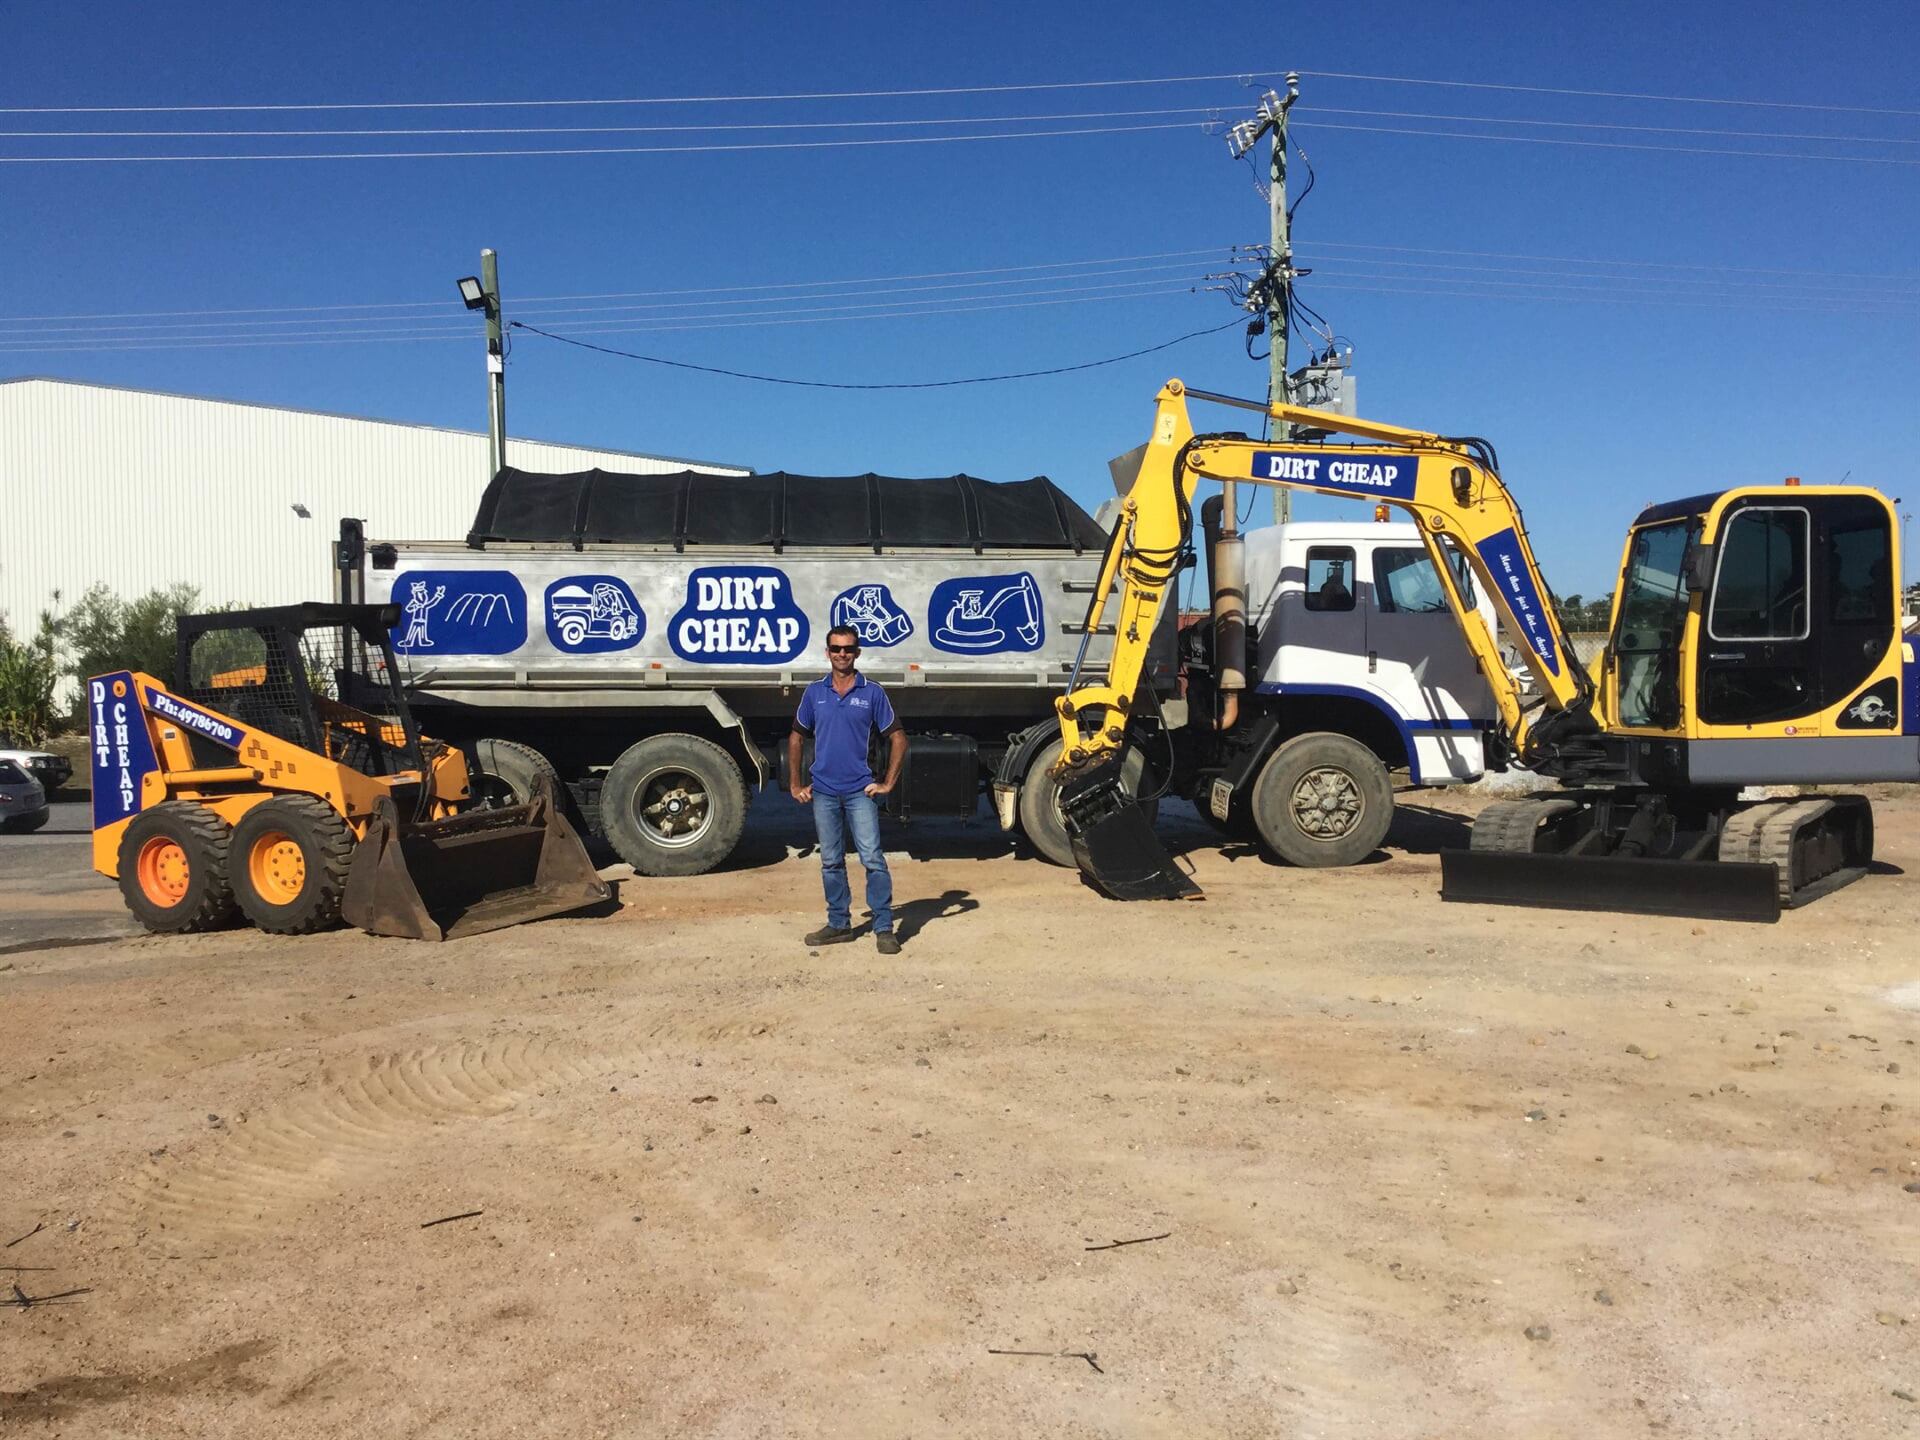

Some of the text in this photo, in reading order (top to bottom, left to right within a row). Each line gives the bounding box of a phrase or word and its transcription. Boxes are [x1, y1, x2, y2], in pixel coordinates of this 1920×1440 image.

[1270, 457, 1398, 486] DIRT CHEAP
[697, 576, 780, 611] DIRT
[1509, 575, 1520, 593] than
[1515, 596, 1529, 611] just
[1536, 636, 1552, 659] cheap!
[678, 617, 799, 653] CHEAP
[92, 681, 110, 767] DIRT
[114, 703, 134, 811] CHEAP
